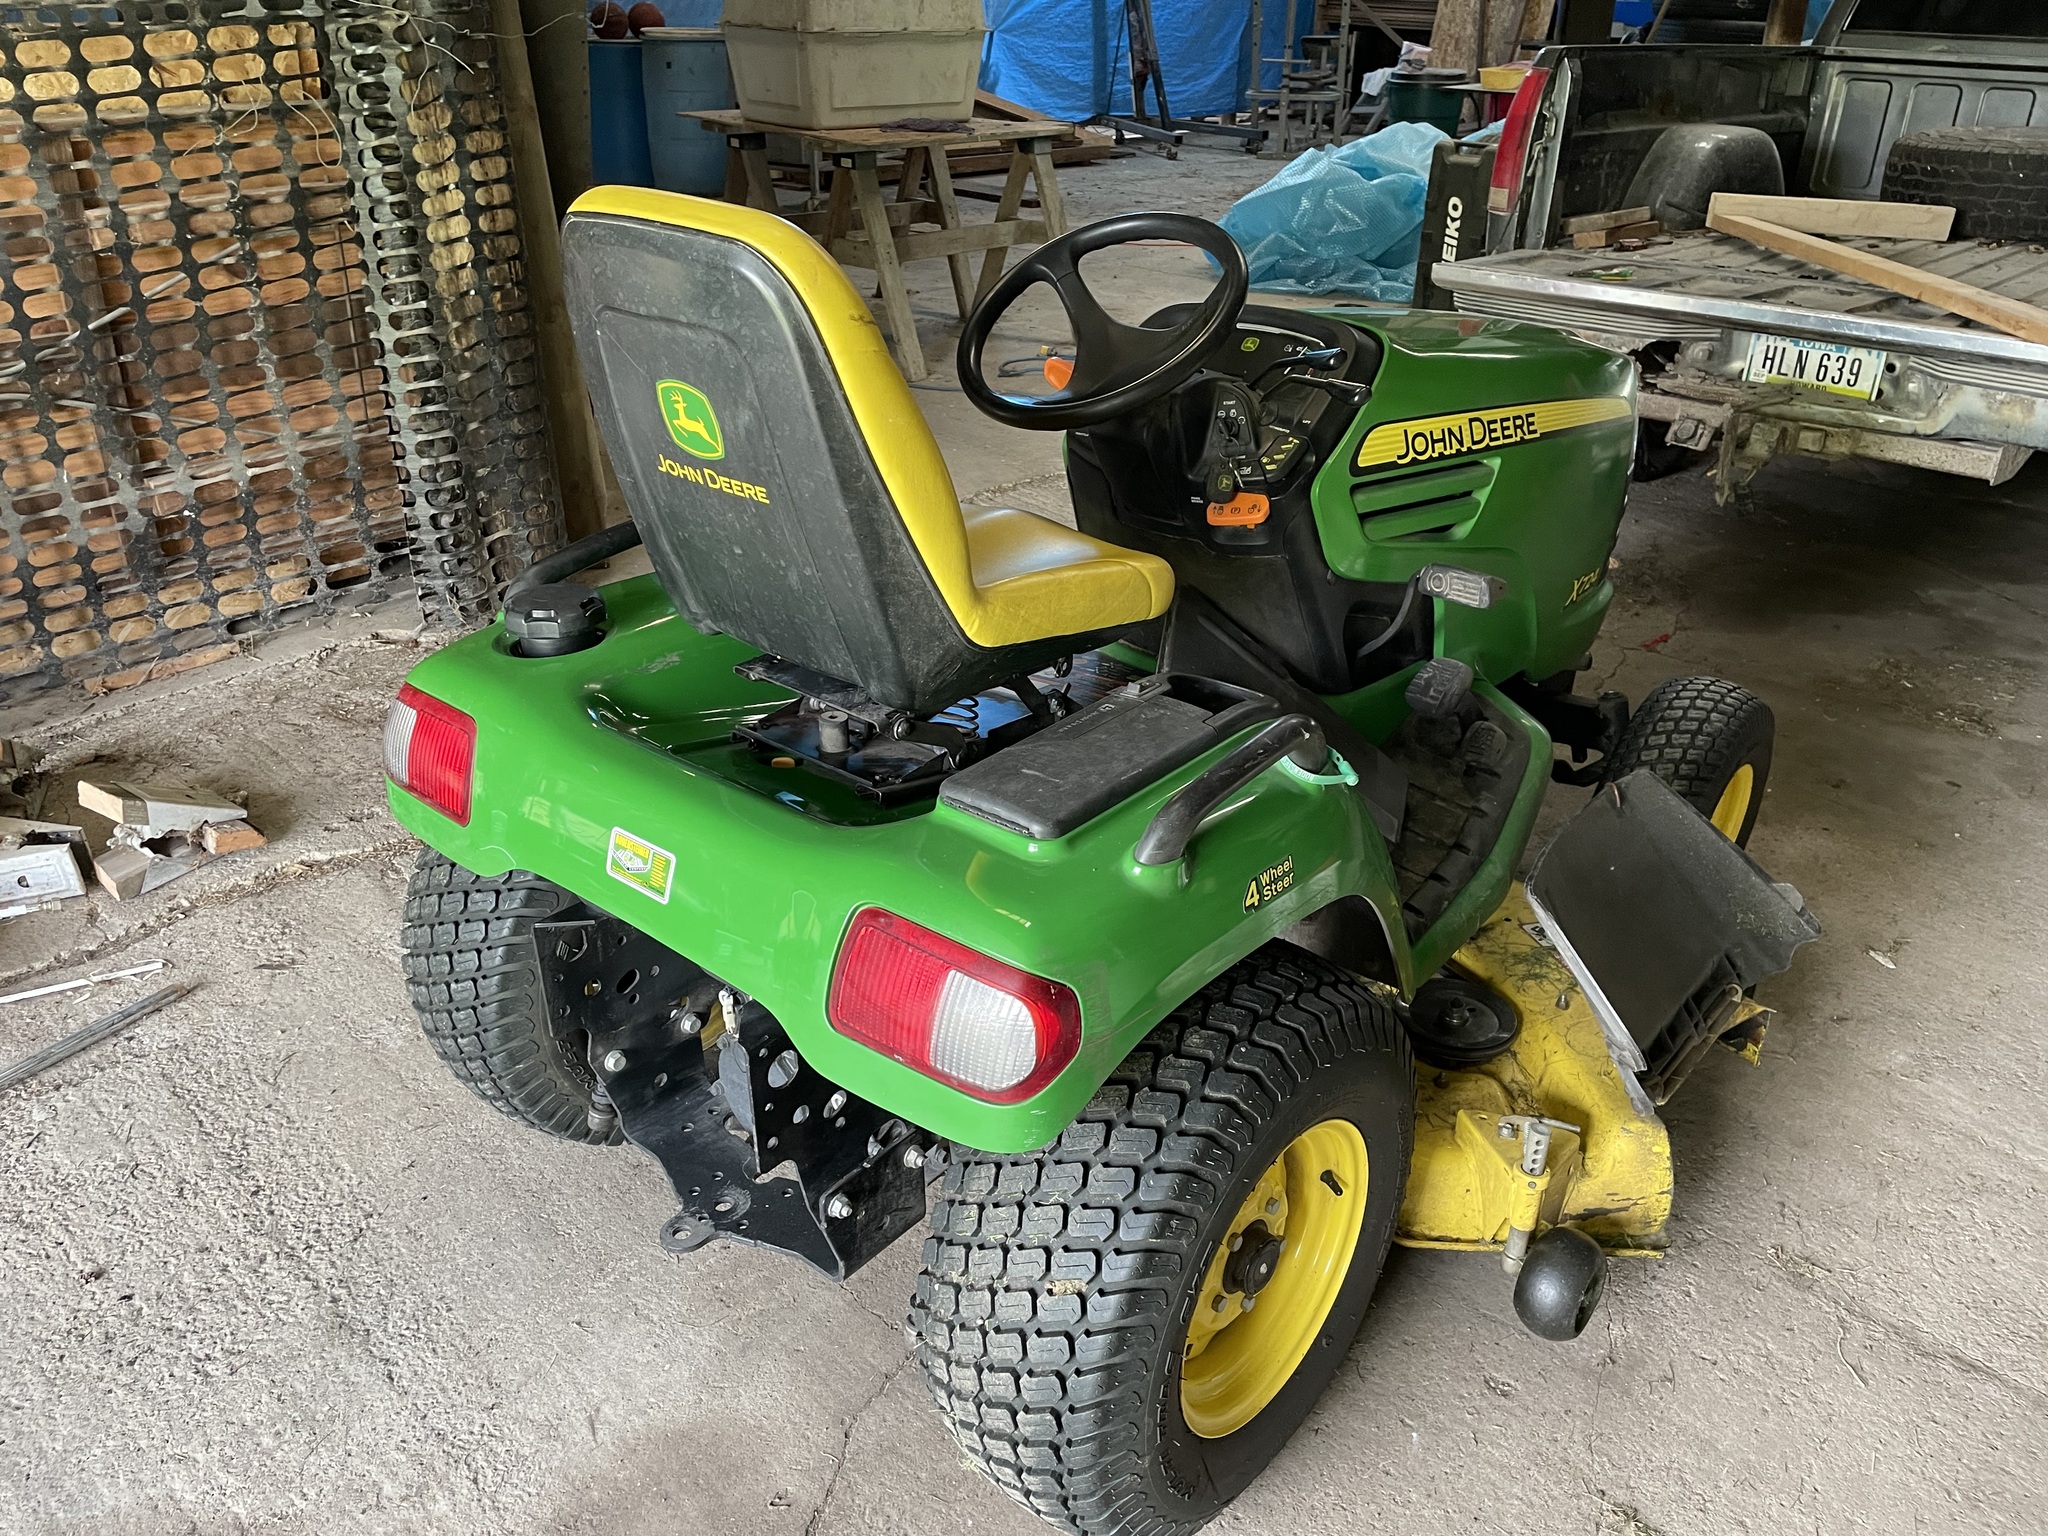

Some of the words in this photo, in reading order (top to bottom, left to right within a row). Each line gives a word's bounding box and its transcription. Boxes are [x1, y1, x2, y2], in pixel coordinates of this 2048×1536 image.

[1441, 196, 1463, 264] EIKO
[1798, 339, 1837, 352] IOWA
[1761, 344, 1810, 379] HLN
[1815, 353, 1863, 387] 639
[1396, 424, 1465, 461] JOHN
[1467, 412, 1539, 446] DEERE
[657, 453, 704, 485] JOHN
[702, 467, 770, 504] DEERE
[1259, 855, 1293, 887] Wheel
[1263, 872, 1294, 901] Steer
[1245, 880, 1260, 908] 4
